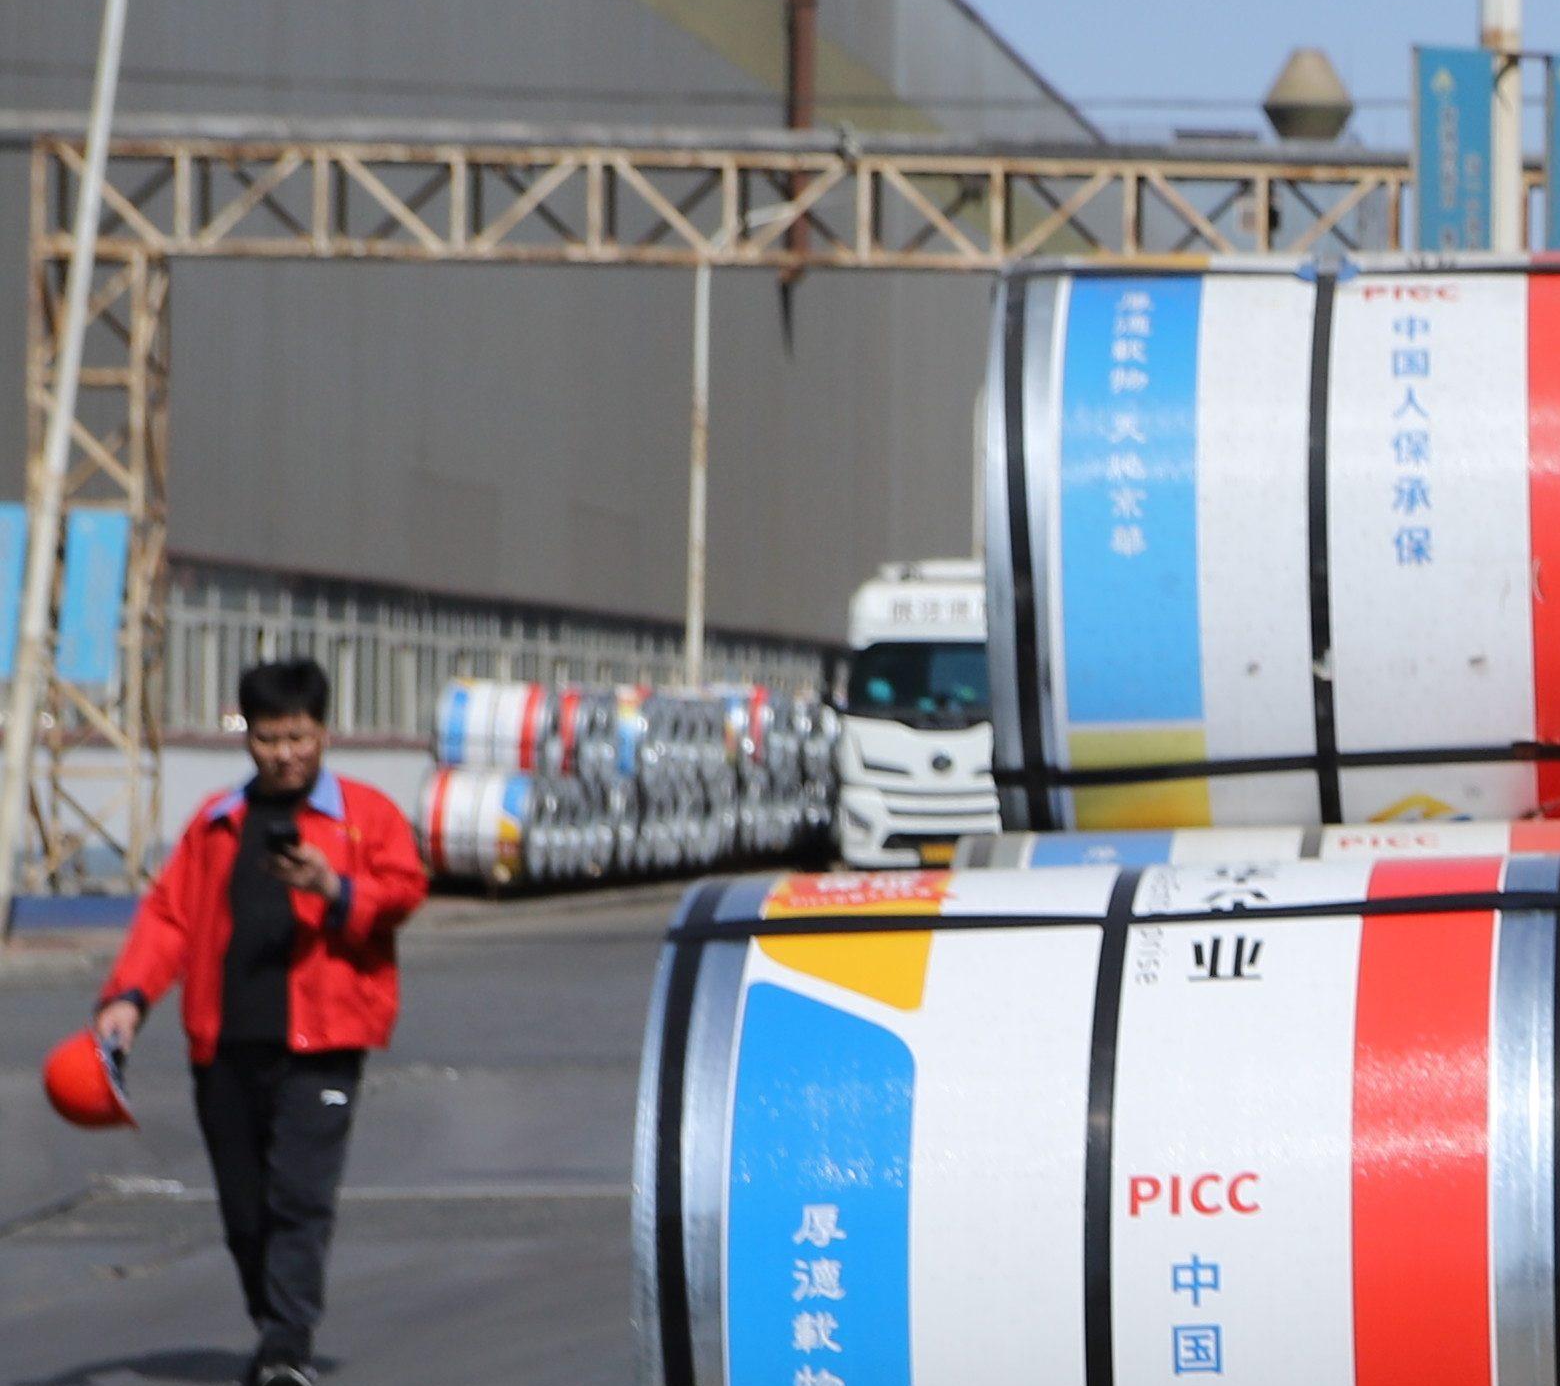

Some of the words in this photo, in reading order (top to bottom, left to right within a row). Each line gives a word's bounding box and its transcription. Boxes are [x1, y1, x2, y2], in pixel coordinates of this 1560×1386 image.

[1390, 313, 1434, 567] 中国人保承保
[1128, 1172, 1262, 1217] PICC
